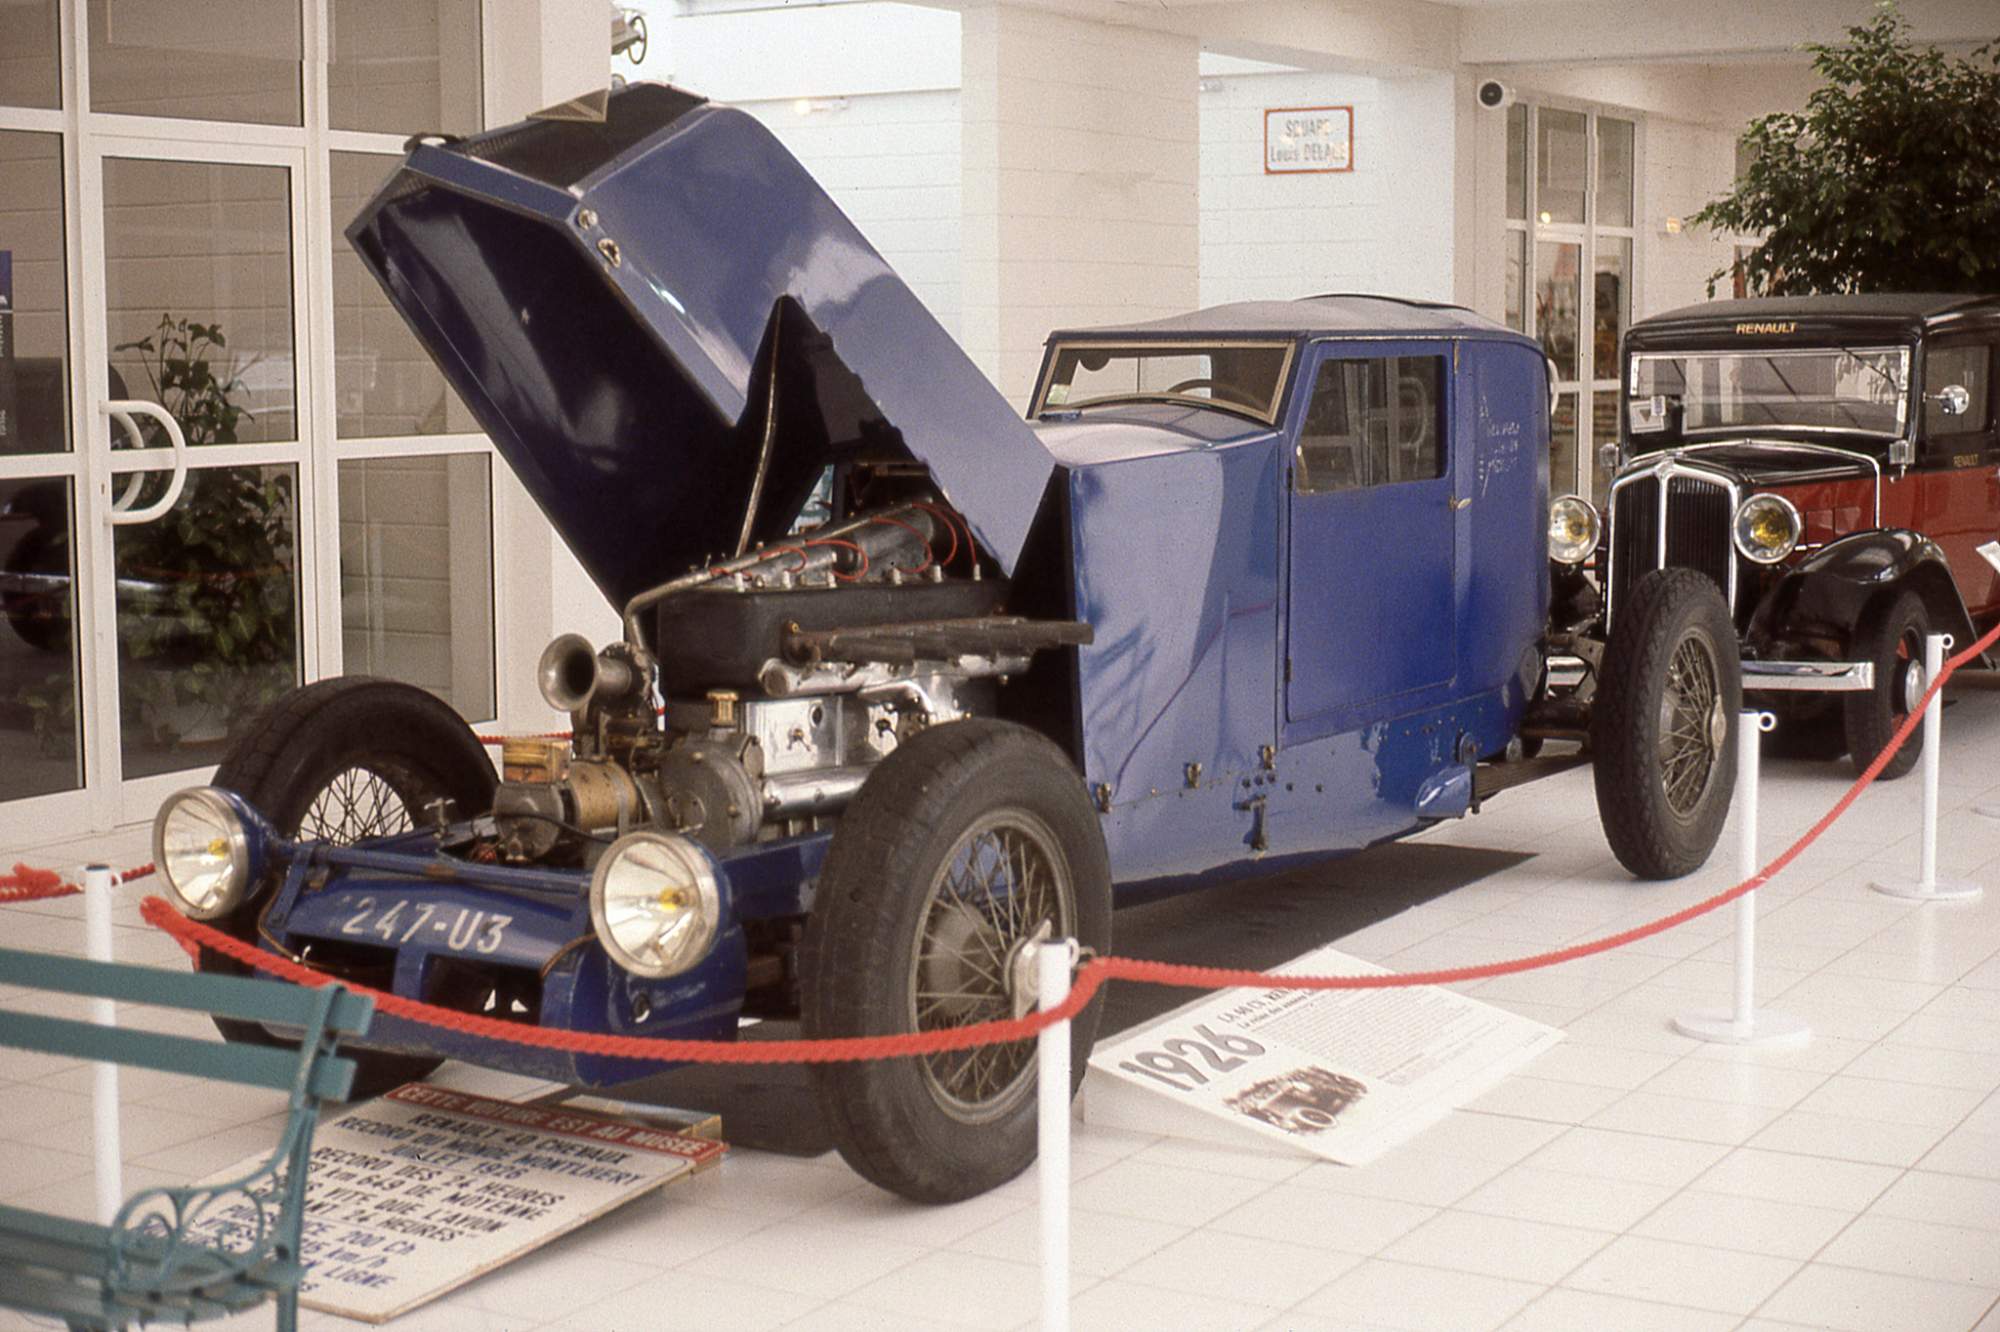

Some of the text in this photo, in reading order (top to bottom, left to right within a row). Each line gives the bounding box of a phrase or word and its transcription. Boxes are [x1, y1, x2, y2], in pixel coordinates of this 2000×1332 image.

[1736, 322, 1798, 335] RENAULT
[1119, 1024, 1266, 1091] 1926
[334, 1116, 418, 1139] RECORD
[408, 1114, 503, 1138] RENAULT
[534, 1139, 631, 1164] CHEVAUX
[307, 1147, 395, 1171] RECORD
[394, 1165, 442, 1181] DES
[442, 1175, 479, 1188] 24
[475, 1181, 567, 1206] HEURES
[470, 1161, 530, 1179] 1926
[323, 1187, 378, 1204] VITE
[373, 1198, 423, 1214] QUE
[403, 1185, 439, 1198] DE
[440, 1192, 551, 1220] MOYENNE
[342, 1209, 379, 1222] 24
[336, 1230, 388, 1247] 200
[320, 1265, 399, 1288] LIGNE
